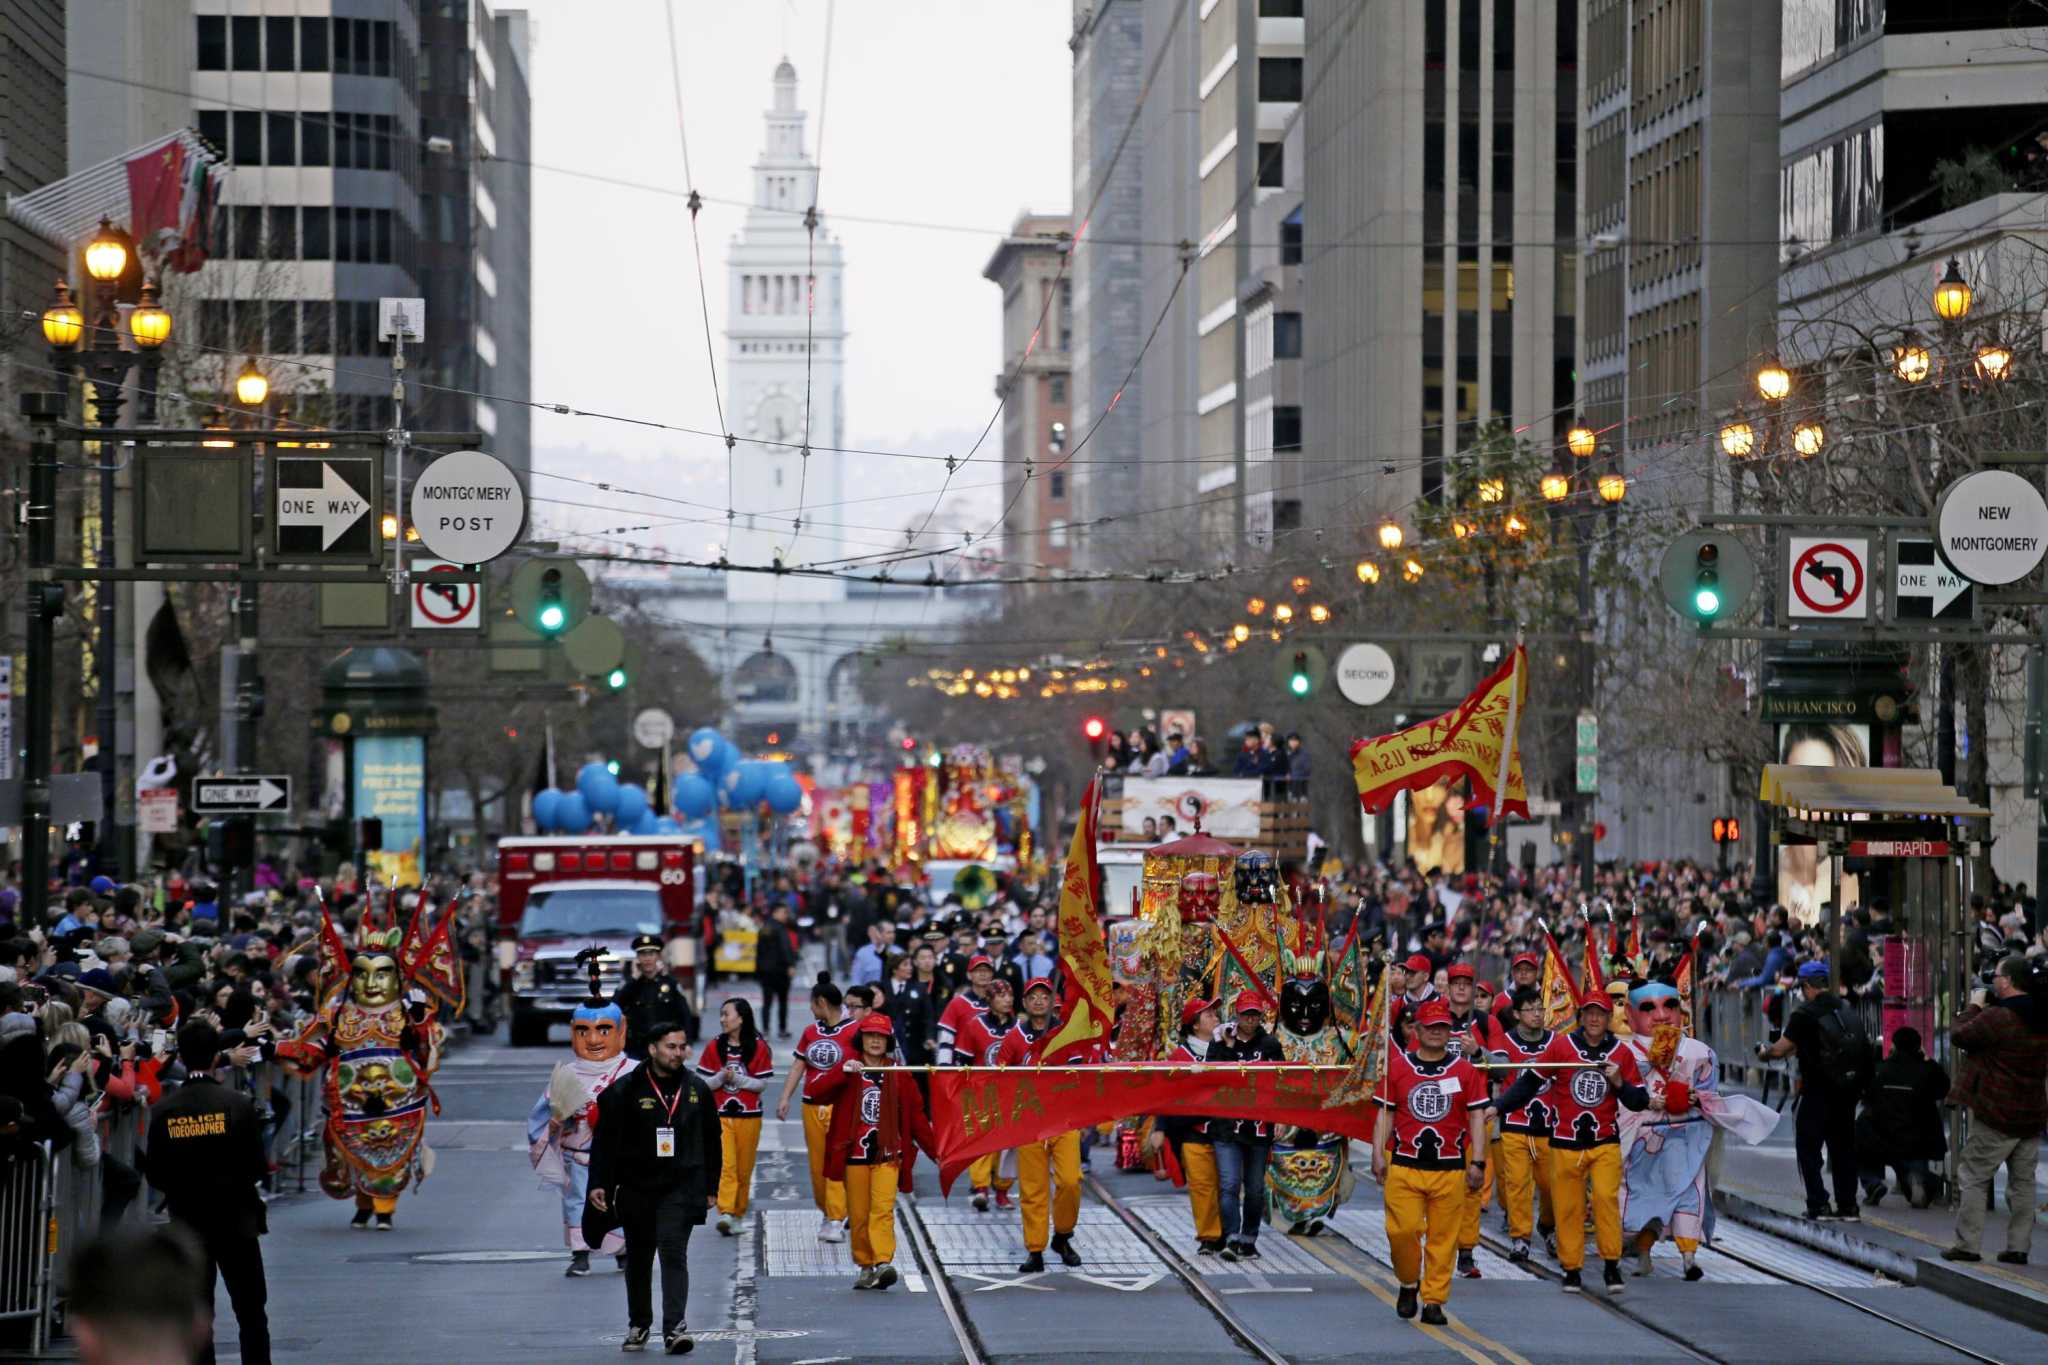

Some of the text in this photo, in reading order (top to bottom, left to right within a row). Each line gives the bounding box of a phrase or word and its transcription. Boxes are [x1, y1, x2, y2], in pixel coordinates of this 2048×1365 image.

[282, 501, 361, 514] ONE WAY
[1978, 506, 2011, 520] NEW
[439, 517, 494, 531] POST
[1951, 537, 2038, 551] MONTGOMERY
[1900, 576, 1964, 587] ONE WAY
[1344, 669, 1389, 680] SECOND
[1787, 701, 1857, 714] FRANCISCO
[205, 788, 229, 801] ONE
[1895, 841, 1932, 856] RAPID
[660, 868, 685, 885] 60
[167, 1112, 225, 1127] POLICE
[168, 1121, 226, 1139] VIDEOGRAPHER
